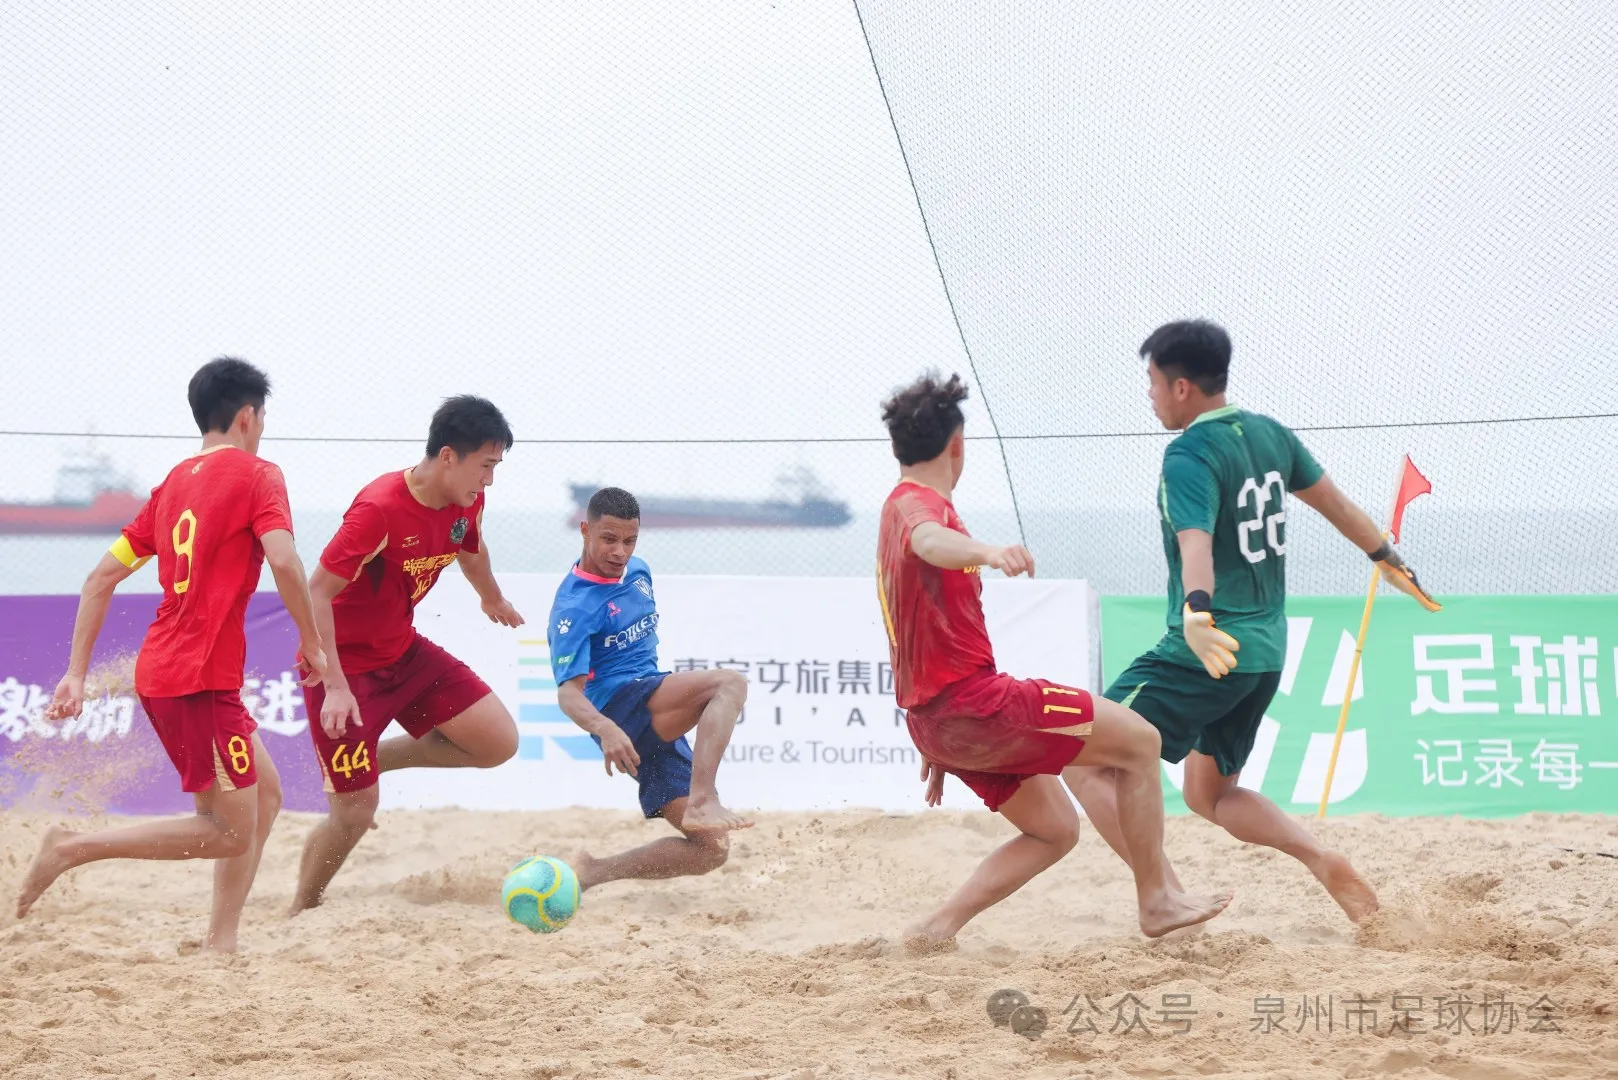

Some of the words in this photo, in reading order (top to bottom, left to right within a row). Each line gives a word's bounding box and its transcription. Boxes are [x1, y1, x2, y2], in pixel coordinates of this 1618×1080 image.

[1237, 470, 1286, 563] 22
[1411, 633, 1618, 716] 足球
[227, 735, 250, 775] 8
[331, 740, 371, 779] 44
[806, 741, 917, 764] Tourism
